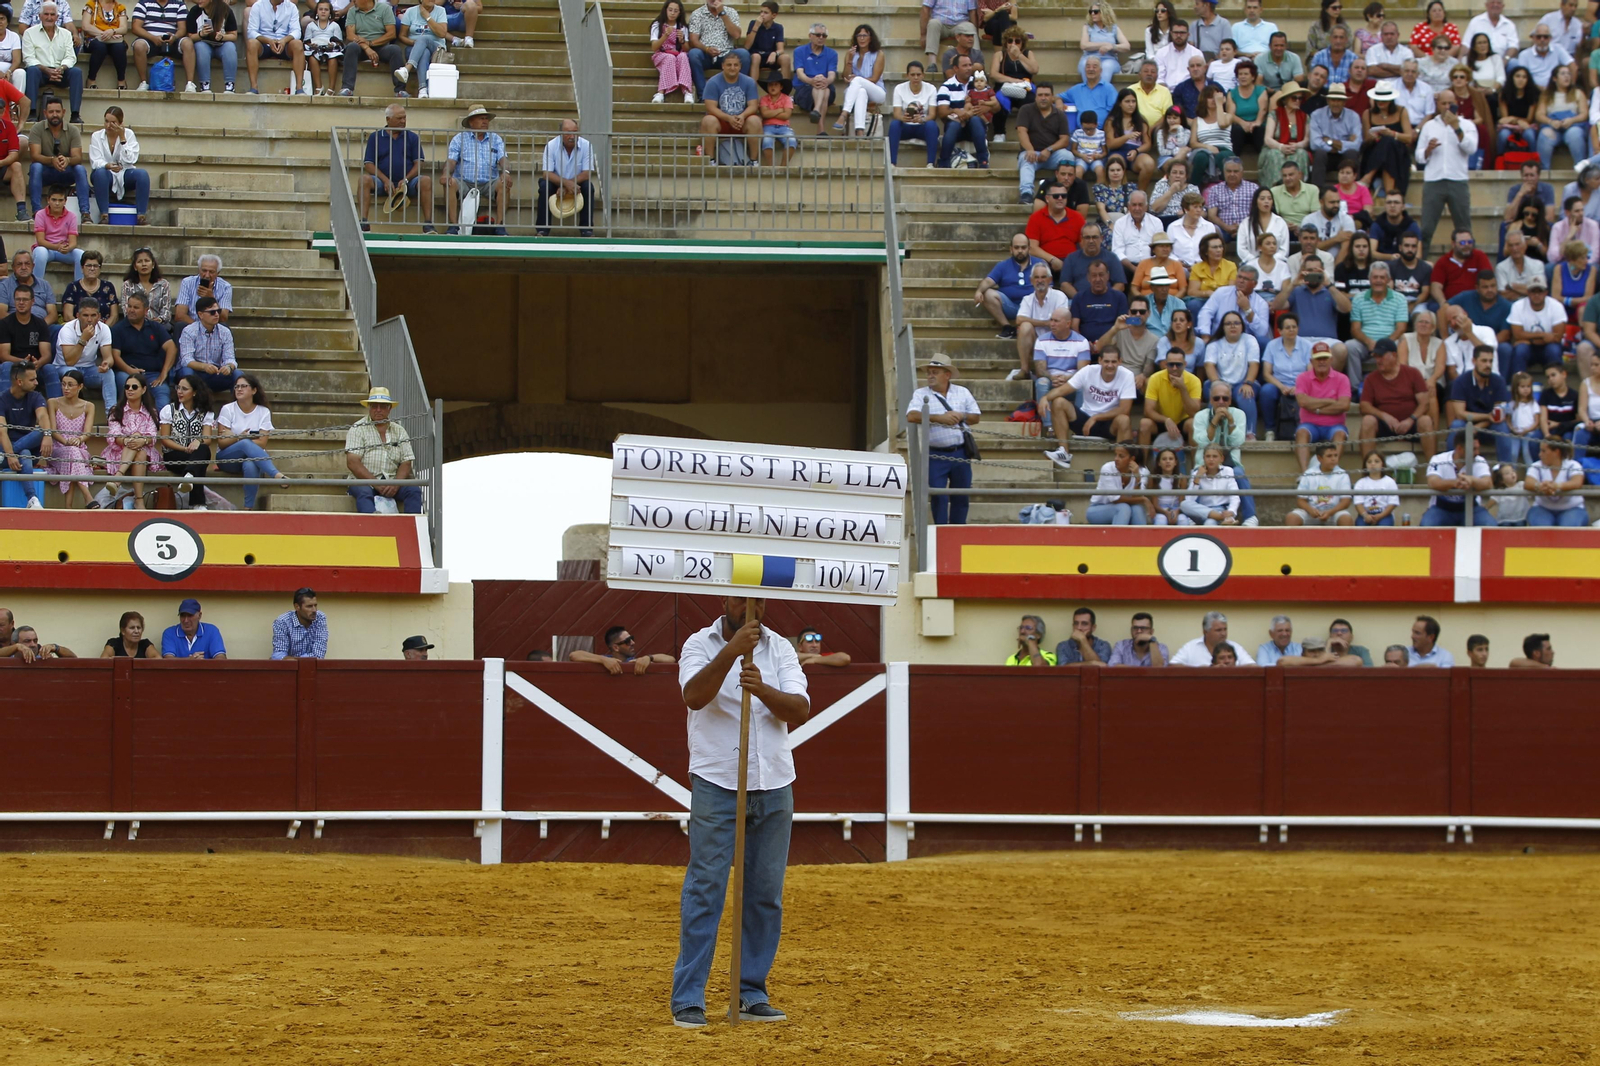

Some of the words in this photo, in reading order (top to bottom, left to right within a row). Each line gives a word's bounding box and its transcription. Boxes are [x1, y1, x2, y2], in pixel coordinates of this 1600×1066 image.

[617, 447, 902, 489] TORRESTRELLA
[156, 535, 178, 560] 5
[1186, 549, 1201, 572] 1
[683, 557, 712, 580] 28
[818, 563, 886, 591] 10/17
